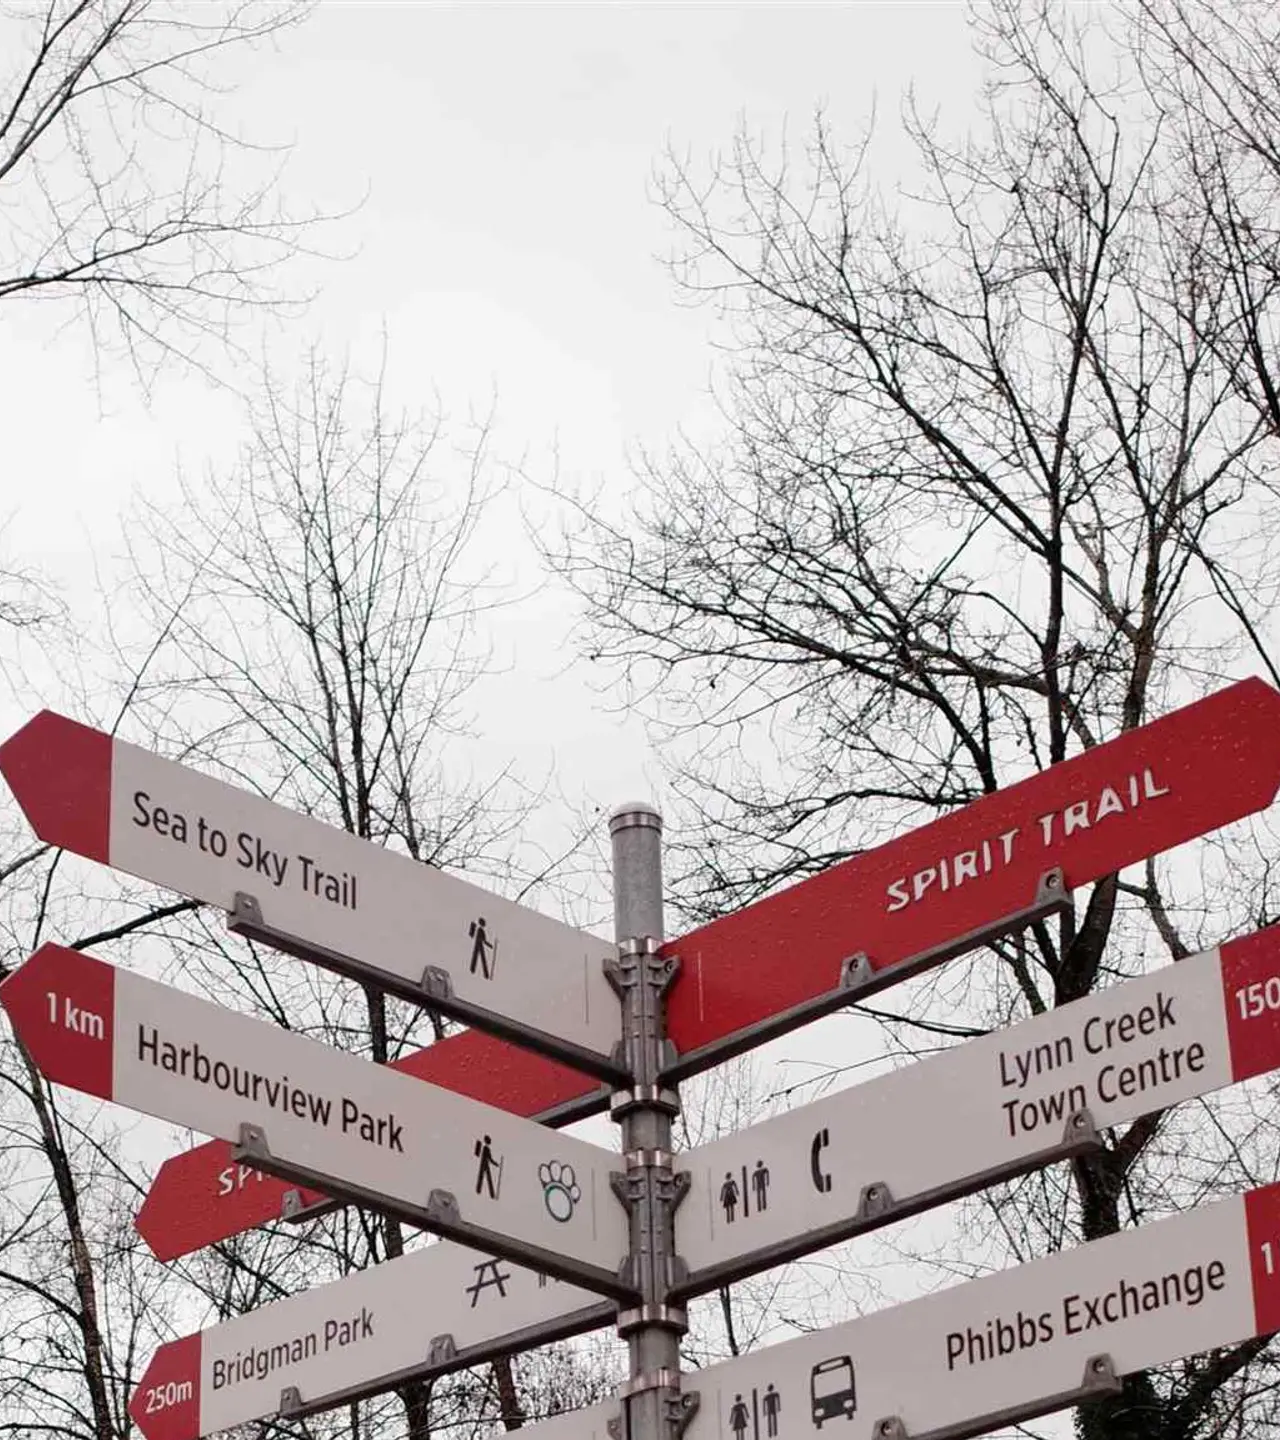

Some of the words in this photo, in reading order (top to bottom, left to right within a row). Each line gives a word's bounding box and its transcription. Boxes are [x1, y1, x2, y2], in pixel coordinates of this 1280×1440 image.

[132, 791, 187, 844] Sea
[197, 817, 227, 858] to
[236, 832, 289, 886] Sky
[297, 855, 357, 910] Trail
[887, 828, 1019, 912] SPIRIT
[1039, 769, 1169, 846] TRAIL
[47, 992, 57, 1023] 1
[65, 997, 104, 1040] km
[999, 1036, 1074, 1089] Lynn
[1083, 992, 1176, 1055] Creek
[138, 1024, 332, 1127] Harbourview
[342, 1099, 404, 1153] Park
[1002, 1084, 1087, 1137] Town
[1097, 1042, 1205, 1104] Centre
[1260, 1241, 1274, 1275] 1
[212, 1333, 317, 1391] Bridgman
[324, 1307, 374, 1352] Park
[946, 1311, 1054, 1371] Phibbs
[1063, 1260, 1225, 1335] Exchange
[145, 1380, 193, 1414] 250m
